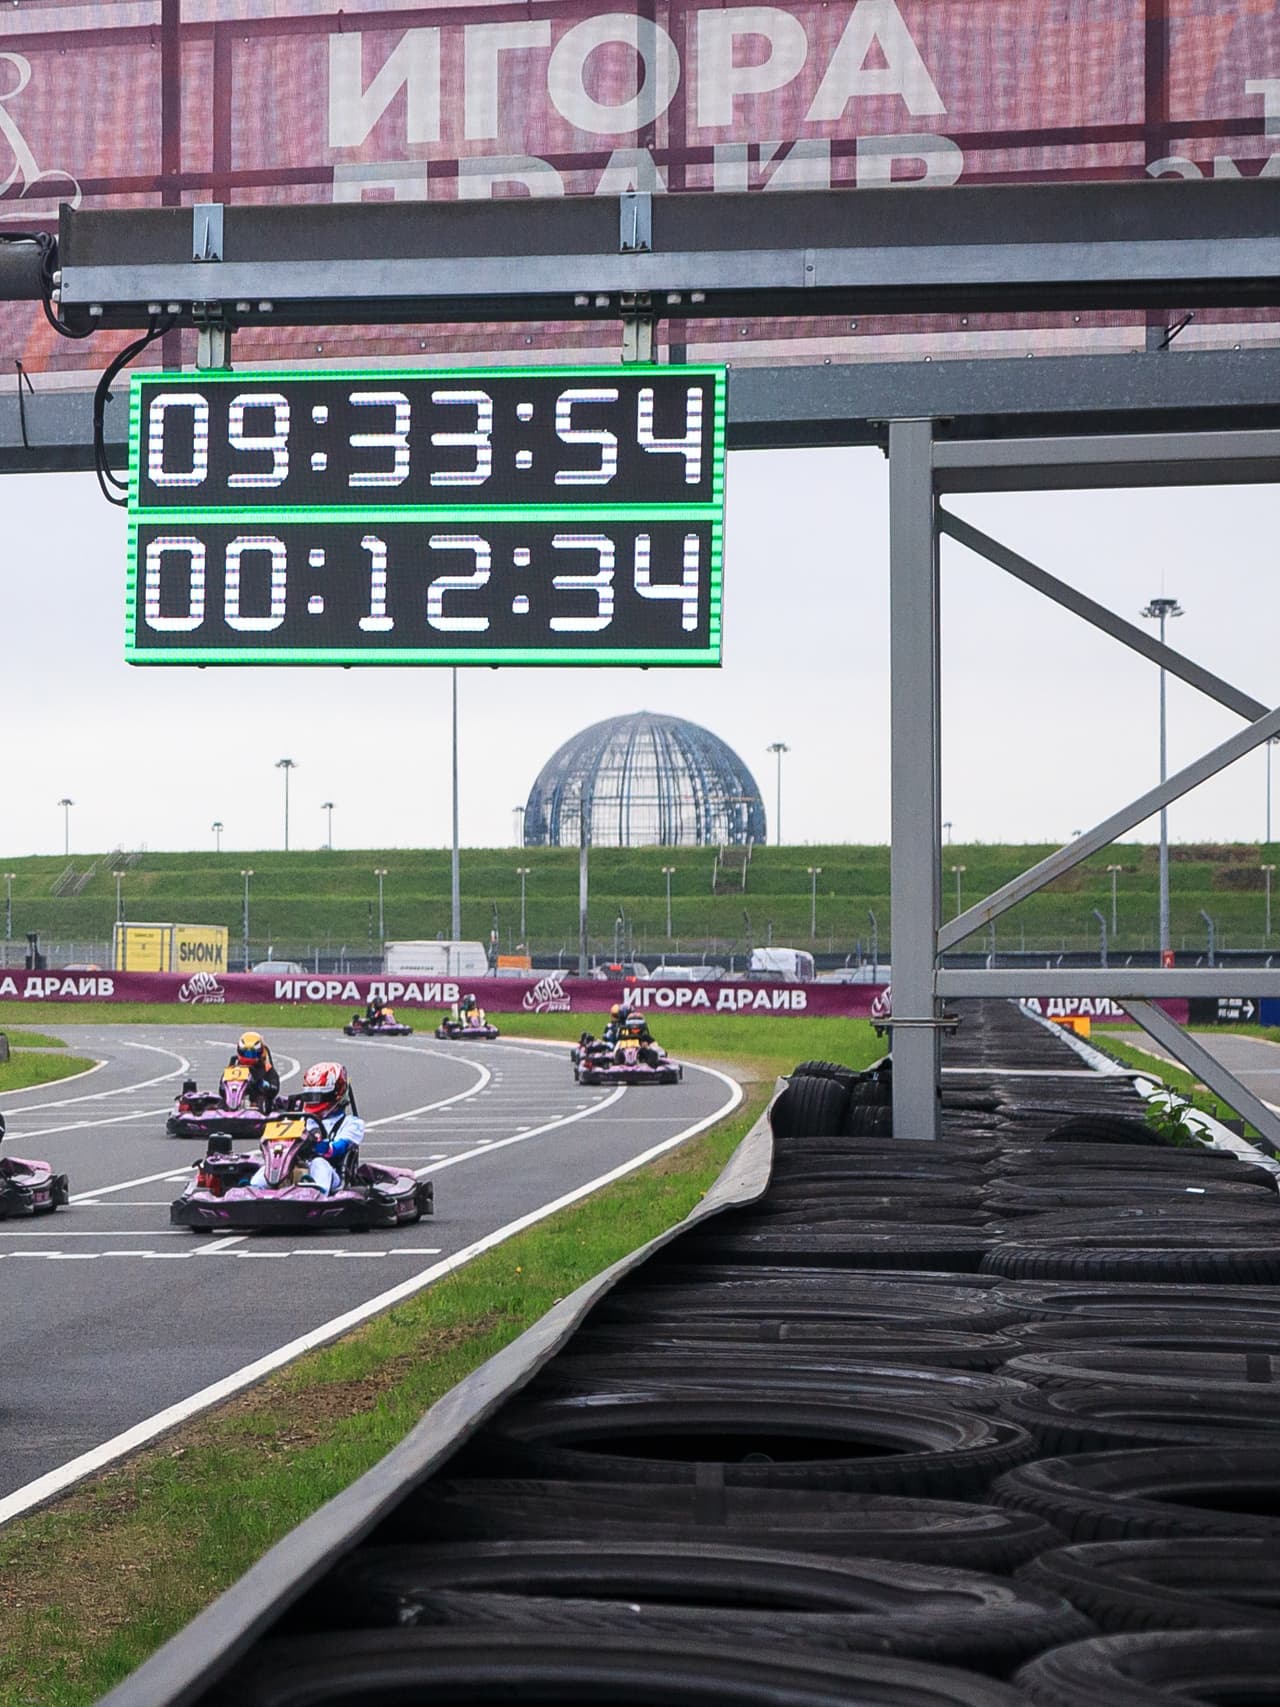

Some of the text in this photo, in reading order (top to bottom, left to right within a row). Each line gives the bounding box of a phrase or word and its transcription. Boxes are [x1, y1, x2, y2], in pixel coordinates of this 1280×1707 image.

[328, 0, 948, 148] ИГОРА
[148, 387, 703, 487] 09:33:54
[145, 534, 700, 632] 00:12:34
[23, 977, 115, 998] ДРАЙВ
[275, 980, 460, 1003] ИГОРА ДРАЙВ
[623, 986, 808, 1011] ИГОРА ДРАЙВ
[276, 1122, 296, 1137] 7
